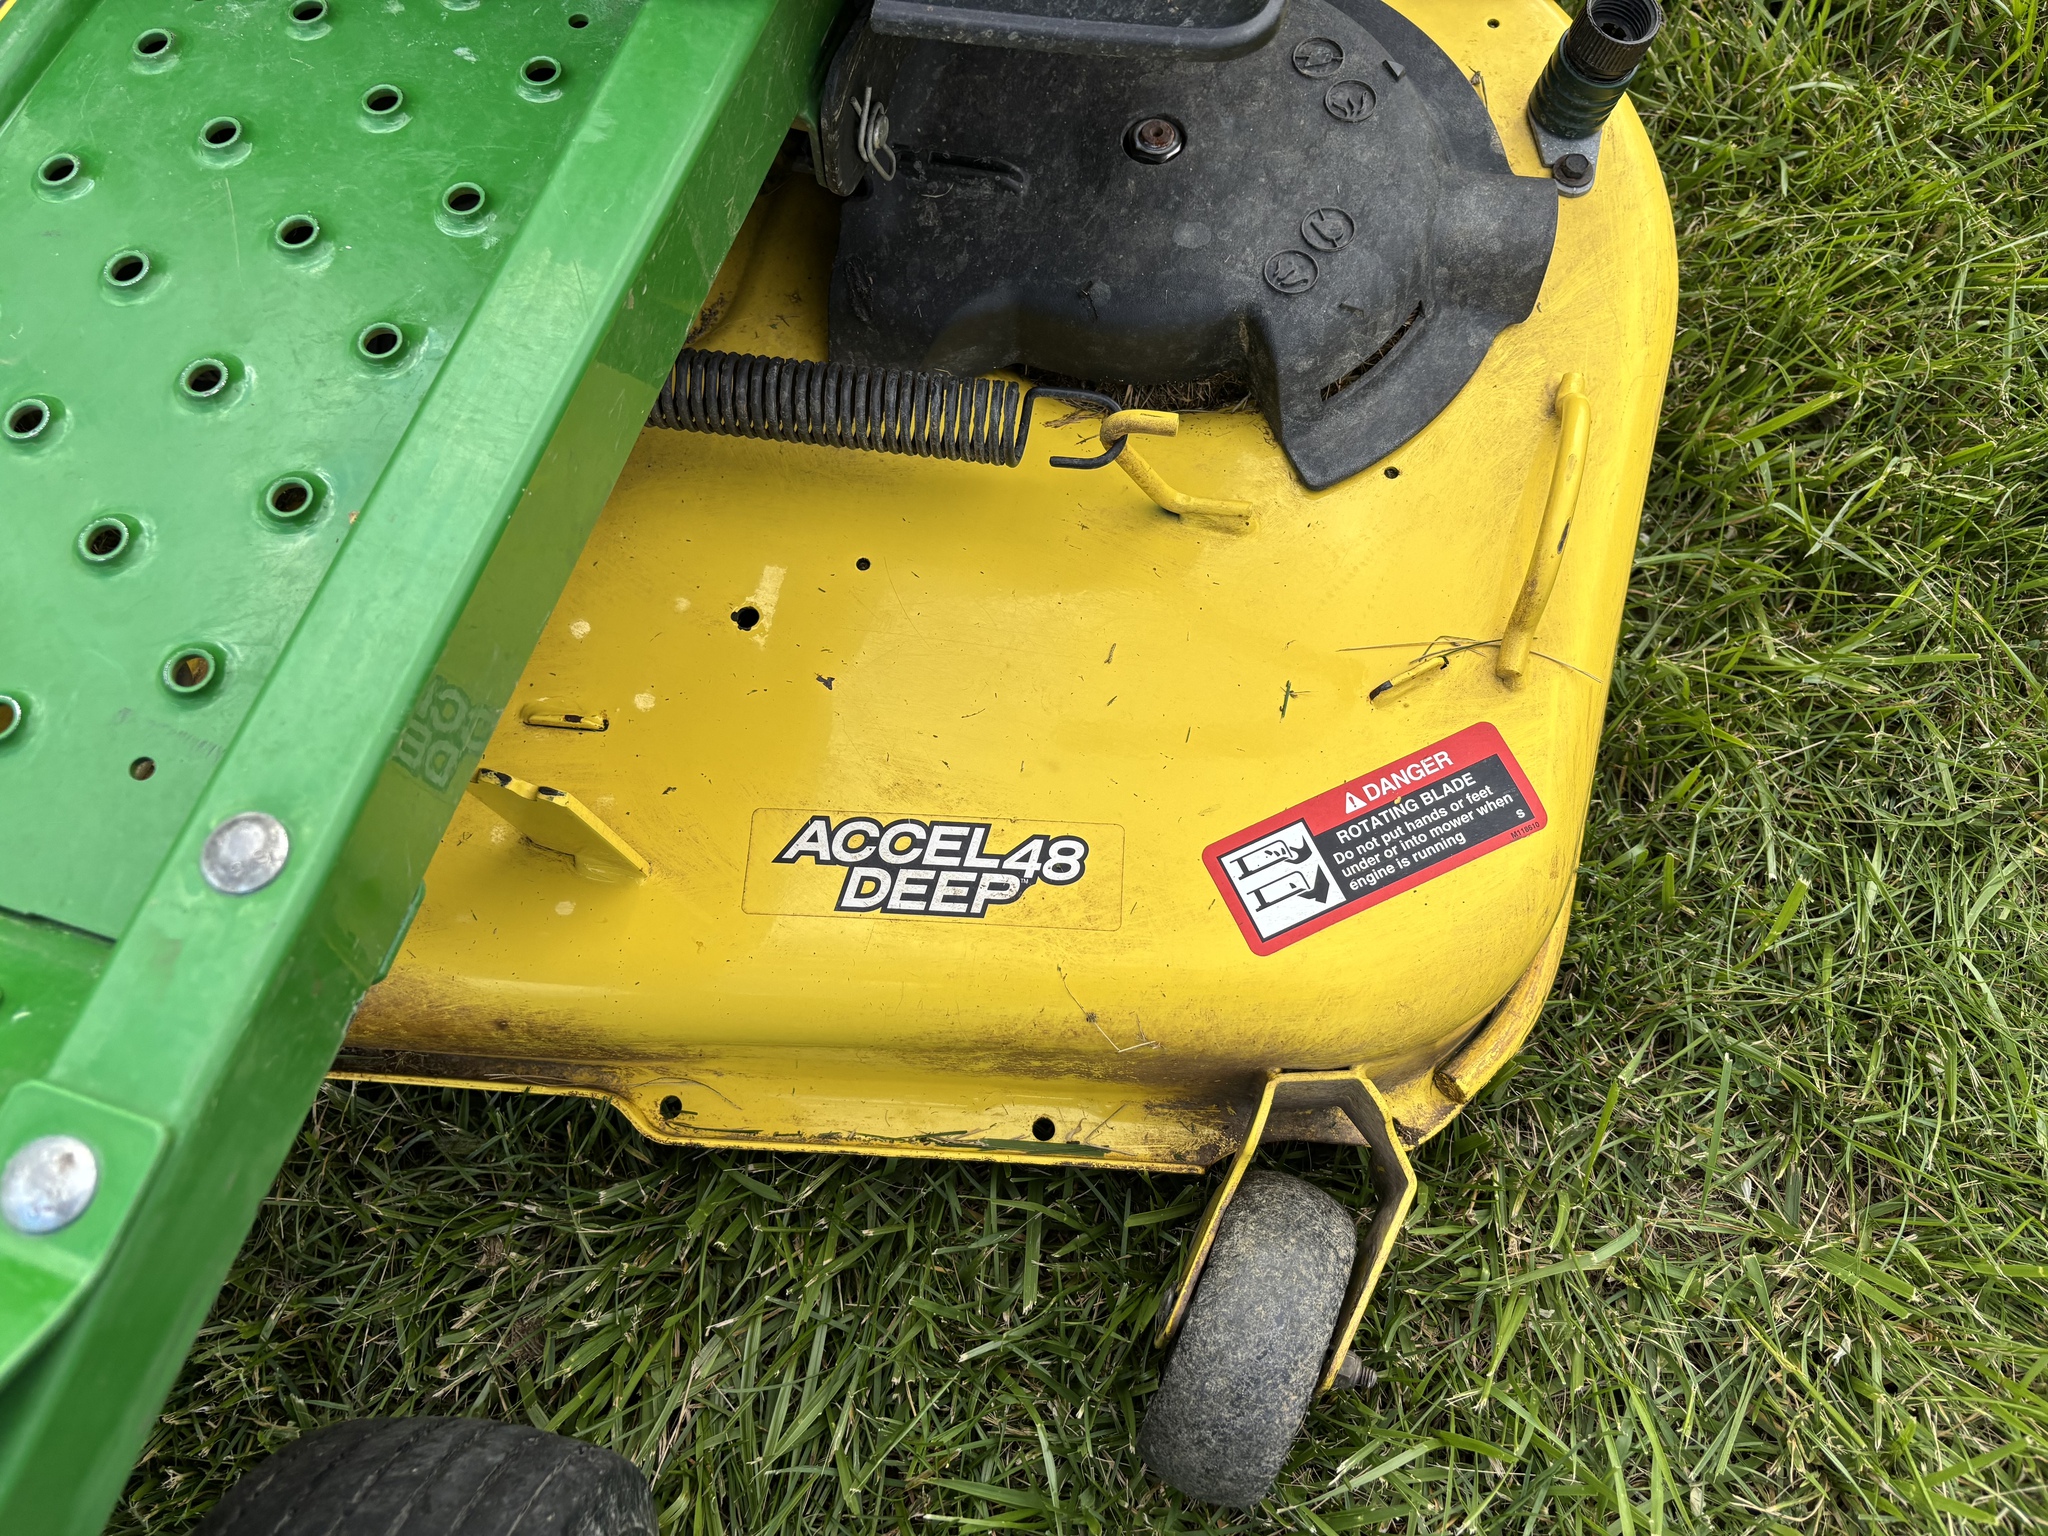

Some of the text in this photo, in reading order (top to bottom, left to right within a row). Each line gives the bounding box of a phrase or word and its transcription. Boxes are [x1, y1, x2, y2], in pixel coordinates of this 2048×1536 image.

[1336, 772, 1477, 844] ROTATING BLADE
[1362, 751, 1454, 802] DANGER
[1333, 785, 1494, 865] Do not put hands or feet
[1341, 794, 1514, 877] under or into mower when
[1349, 832, 1466, 891] engine is running
